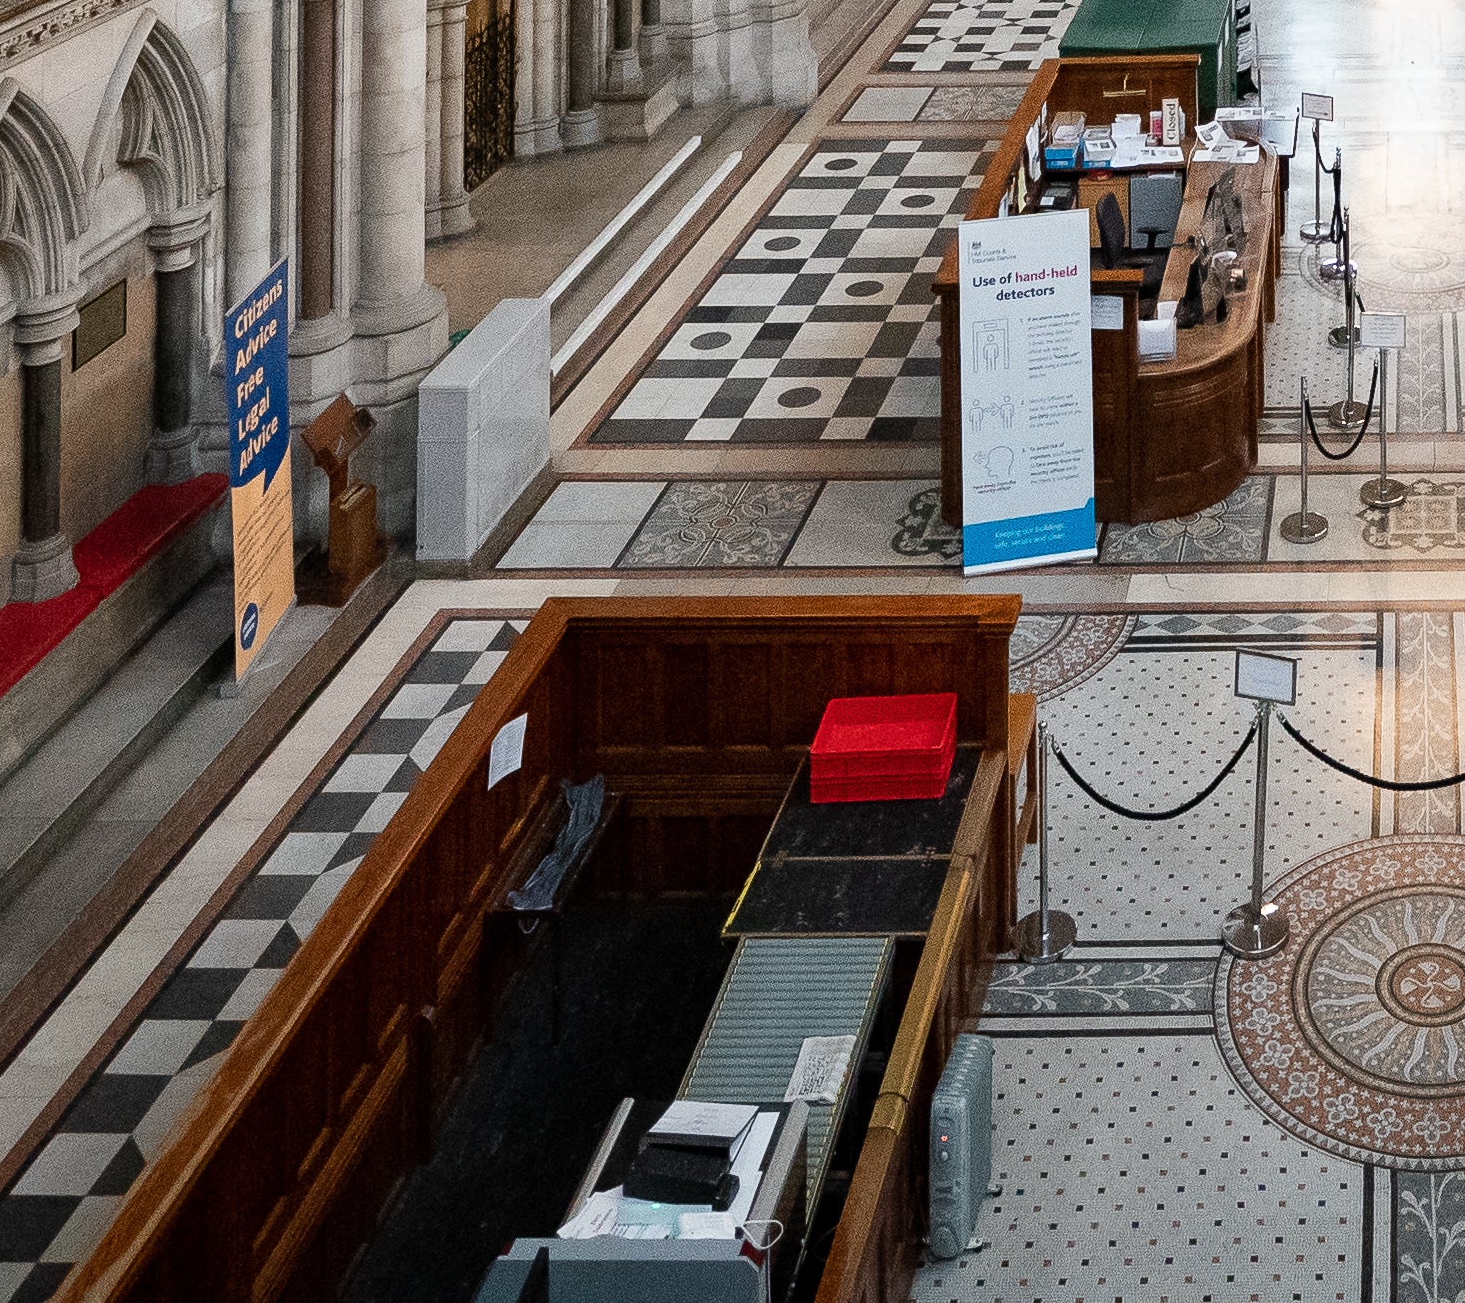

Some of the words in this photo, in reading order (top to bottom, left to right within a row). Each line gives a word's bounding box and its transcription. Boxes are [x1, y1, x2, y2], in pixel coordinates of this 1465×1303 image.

[1166, 103, 1176, 141] Closed
[972, 276, 996, 288] Use
[999, 272, 1012, 284] of
[1015, 265, 1078, 283] hand-held
[996, 286, 1055, 301] detectors
[235, 279, 283, 339] Citizens
[235, 318, 278, 376] Advice
[237, 366, 264, 408] Free
[238, 386, 270, 442] Legal
[239, 416, 278, 477] Advice
